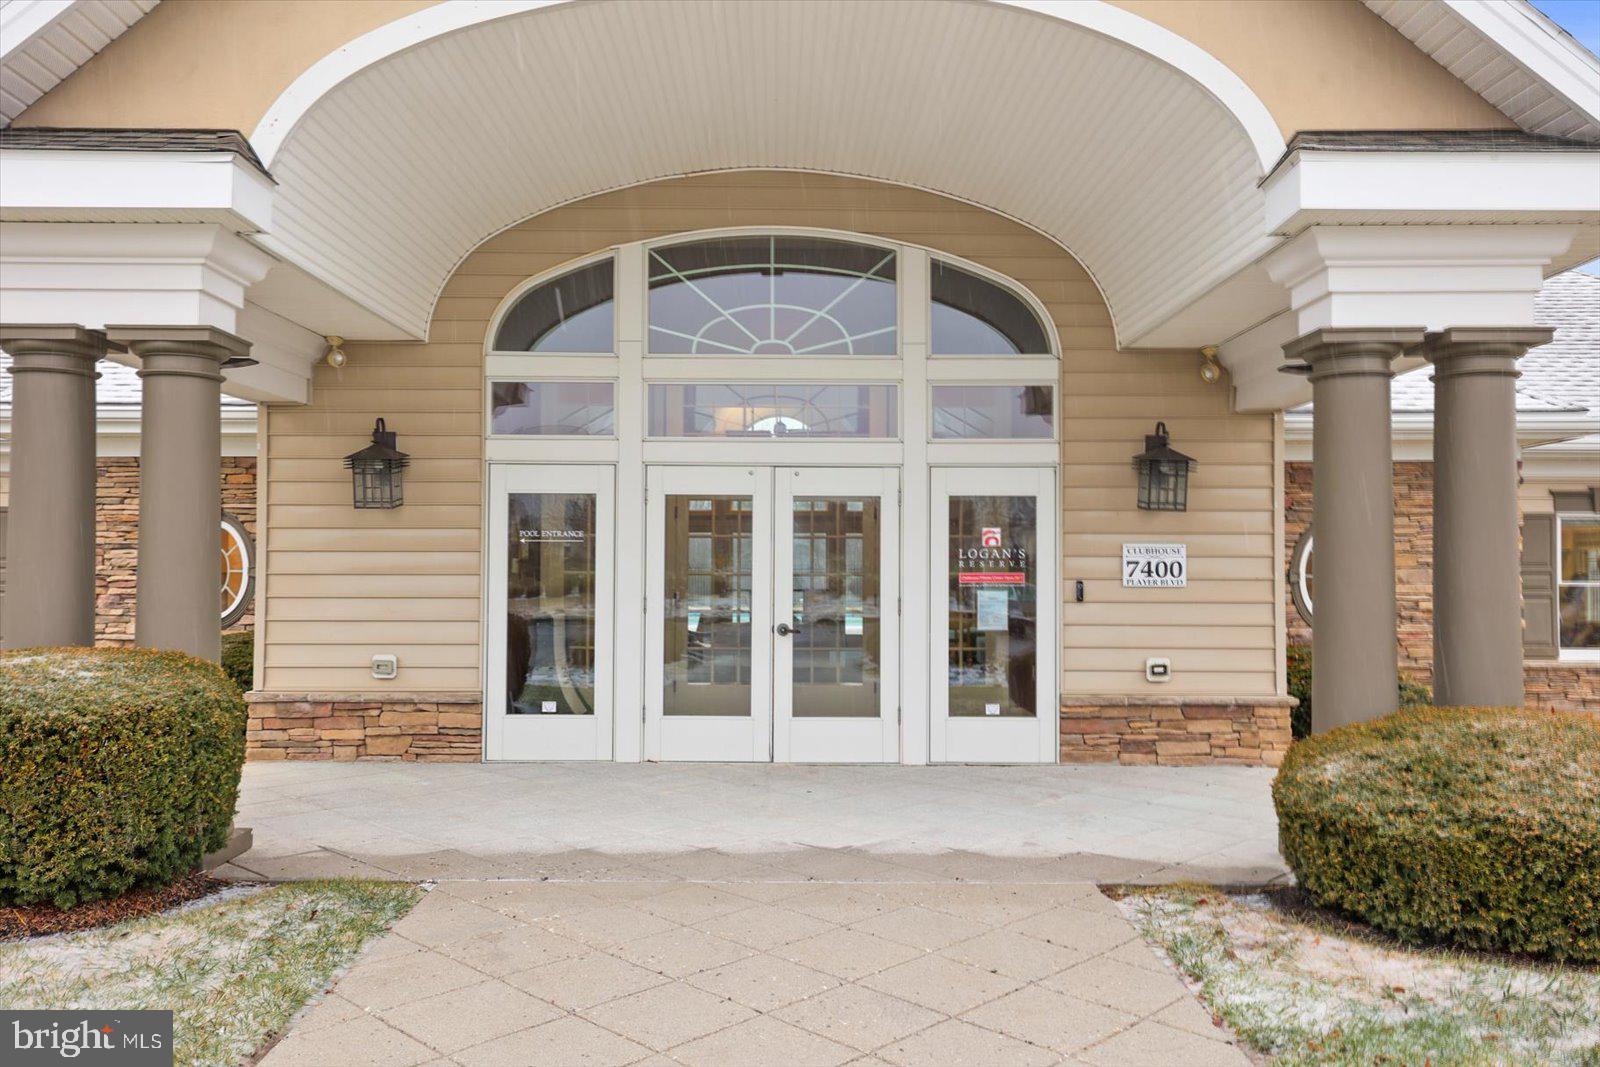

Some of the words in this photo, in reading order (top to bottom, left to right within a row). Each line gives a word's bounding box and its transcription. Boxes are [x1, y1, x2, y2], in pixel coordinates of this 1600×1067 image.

[958, 548, 1026, 559] LOGAN'S
[958, 560, 1026, 568] RESERVE
[1126, 560, 1183, 578] 7400
